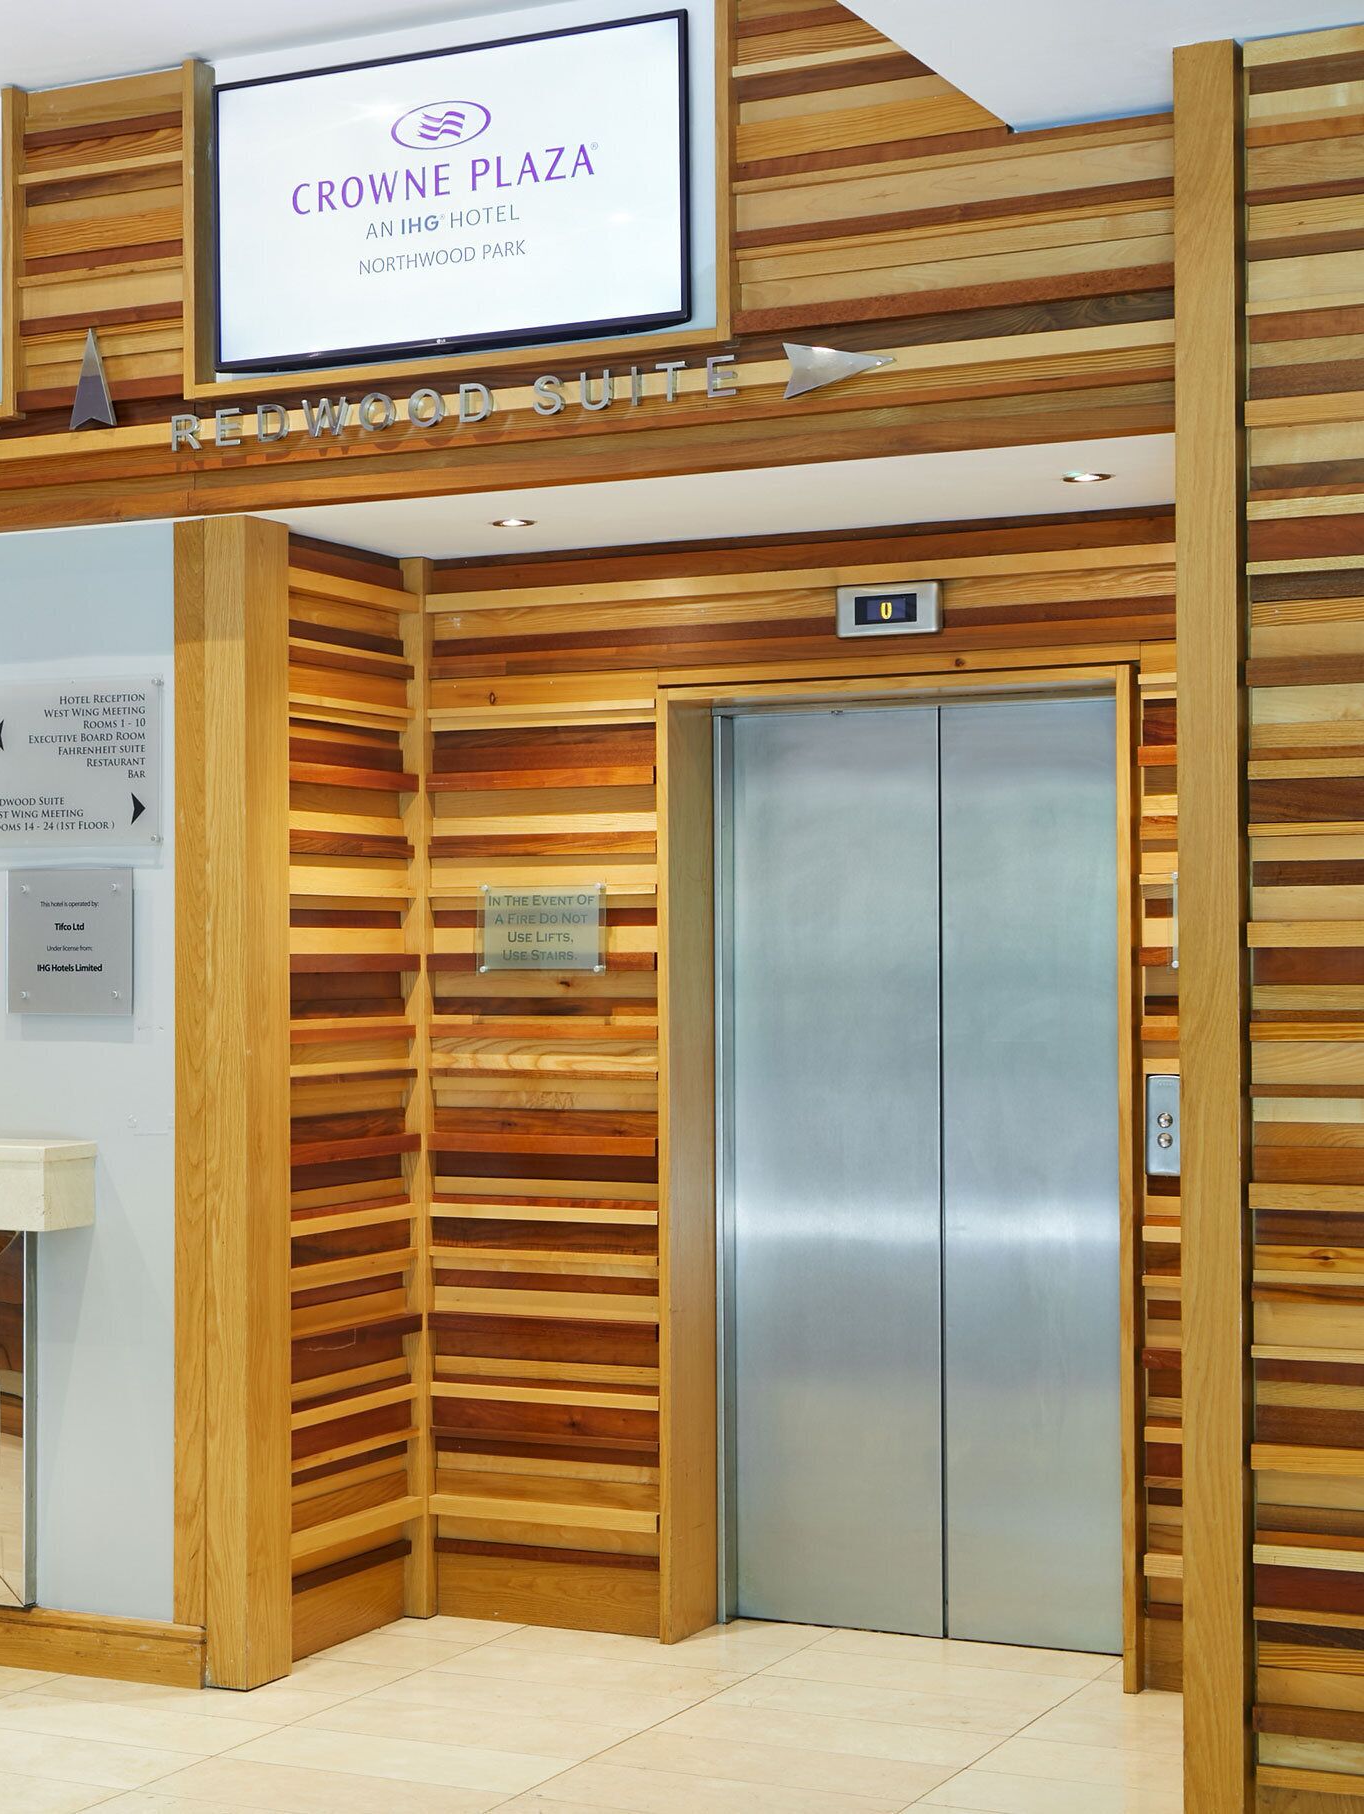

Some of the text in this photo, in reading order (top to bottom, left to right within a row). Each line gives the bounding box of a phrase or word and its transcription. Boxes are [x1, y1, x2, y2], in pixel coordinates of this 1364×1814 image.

[292, 144, 594, 215] CROWNE PLAZA
[366, 204, 520, 239] AN IHG HOTEL
[359, 239, 526, 275] NORTHWOOD PARK
[171, 354, 737, 452] REDWOOD SUITE
[59, 693, 145, 705] HOTEL RECEPTION
[44, 706, 145, 718] WEST WING MEETING
[83, 720, 117, 729] ROOMS
[136, 718, 146, 727] 10
[29, 731, 145, 744] EXECUTIVE BOARD ROOM
[58, 744, 145, 755] FAHRENHEIT SUITE
[87, 757, 146, 767] RESTAURANT
[128, 769, 145, 778] BAR
[39, 796, 65, 805] SUITE
[11, 809, 38, 818] WING
[41, 809, 84, 818] MEETING
[24, 822, 34, 831] 14
[43, 821, 54, 830] 24
[488, 894, 595, 906] IN THE EVENT OF
[494, 913, 588, 925] A FIRE DO NOT
[54, 922, 85, 931] Tifco Ltd
[507, 931, 574, 943] USE LIFTS,
[502, 950, 578, 961] USE STAIRS.
[37, 964, 103, 972] IHG Hotels Limited
